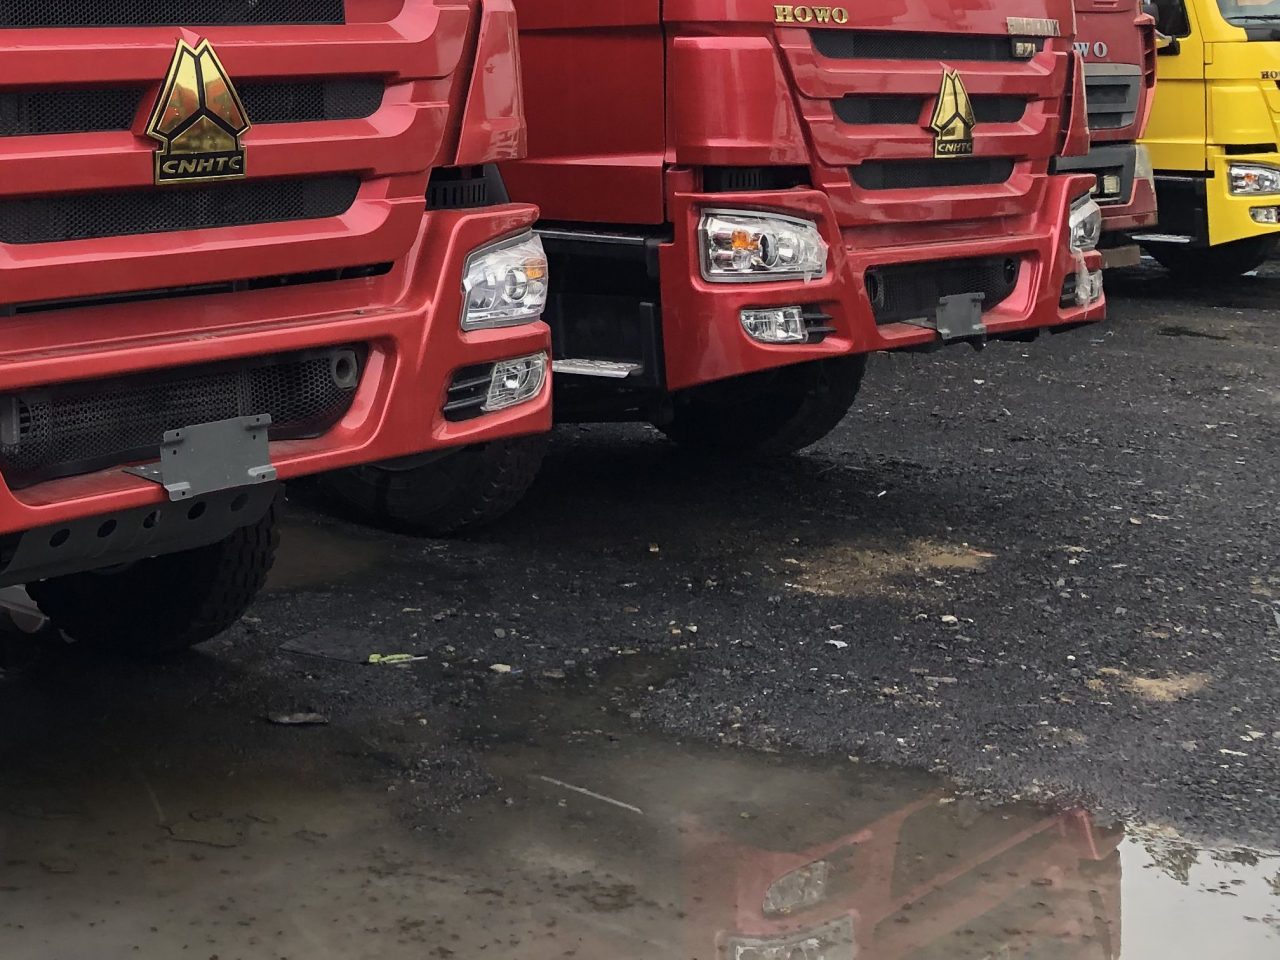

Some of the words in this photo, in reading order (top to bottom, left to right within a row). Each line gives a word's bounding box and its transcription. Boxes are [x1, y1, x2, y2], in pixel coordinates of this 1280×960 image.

[773, 5, 849, 24] HOWO
[1261, 70, 1280, 80] HO
[938, 142, 972, 152] CNHTC
[162, 155, 242, 174] CNHTC
